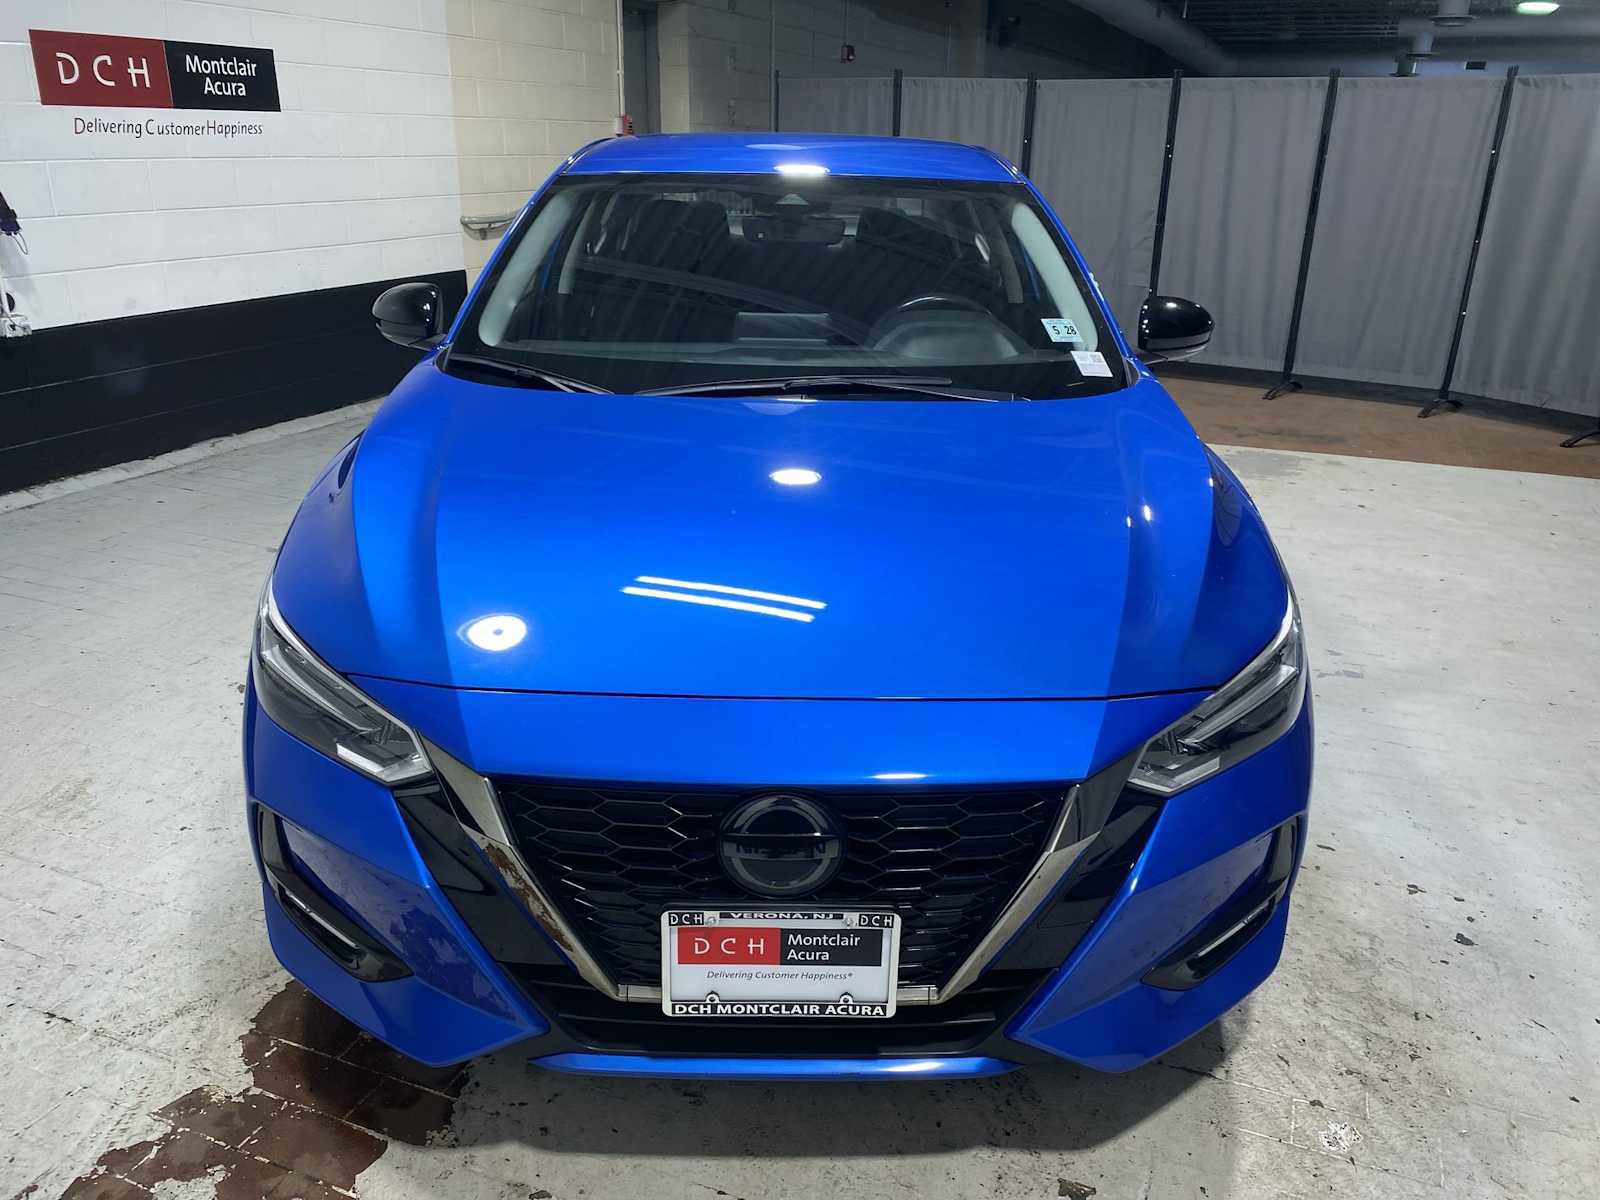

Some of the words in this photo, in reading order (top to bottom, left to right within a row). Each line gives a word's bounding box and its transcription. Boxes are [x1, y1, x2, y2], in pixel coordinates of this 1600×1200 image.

[55, 52, 151, 88] DCH
[185, 54, 257, 77] Montclair
[203, 77, 247, 97] Acura
[74, 117, 142, 138] Delivering
[1052, 325, 1061, 335] 5
[1064, 325, 1077, 336] 28
[735, 841, 826, 855] NIN
[670, 913, 703, 925] DCH
[860, 915, 893, 927] DCH
[694, 938, 764, 955] DCH
[787, 934, 861, 947] Montclair
[787, 949, 830, 961] Acura
[707, 970, 753, 981] Delivering
[755, 971, 799, 980] Customer
[675, 1004, 712, 1014] DCH
[717, 1004, 820, 1015] MONTCLAIR
[825, 1005, 884, 1016] ACURA
